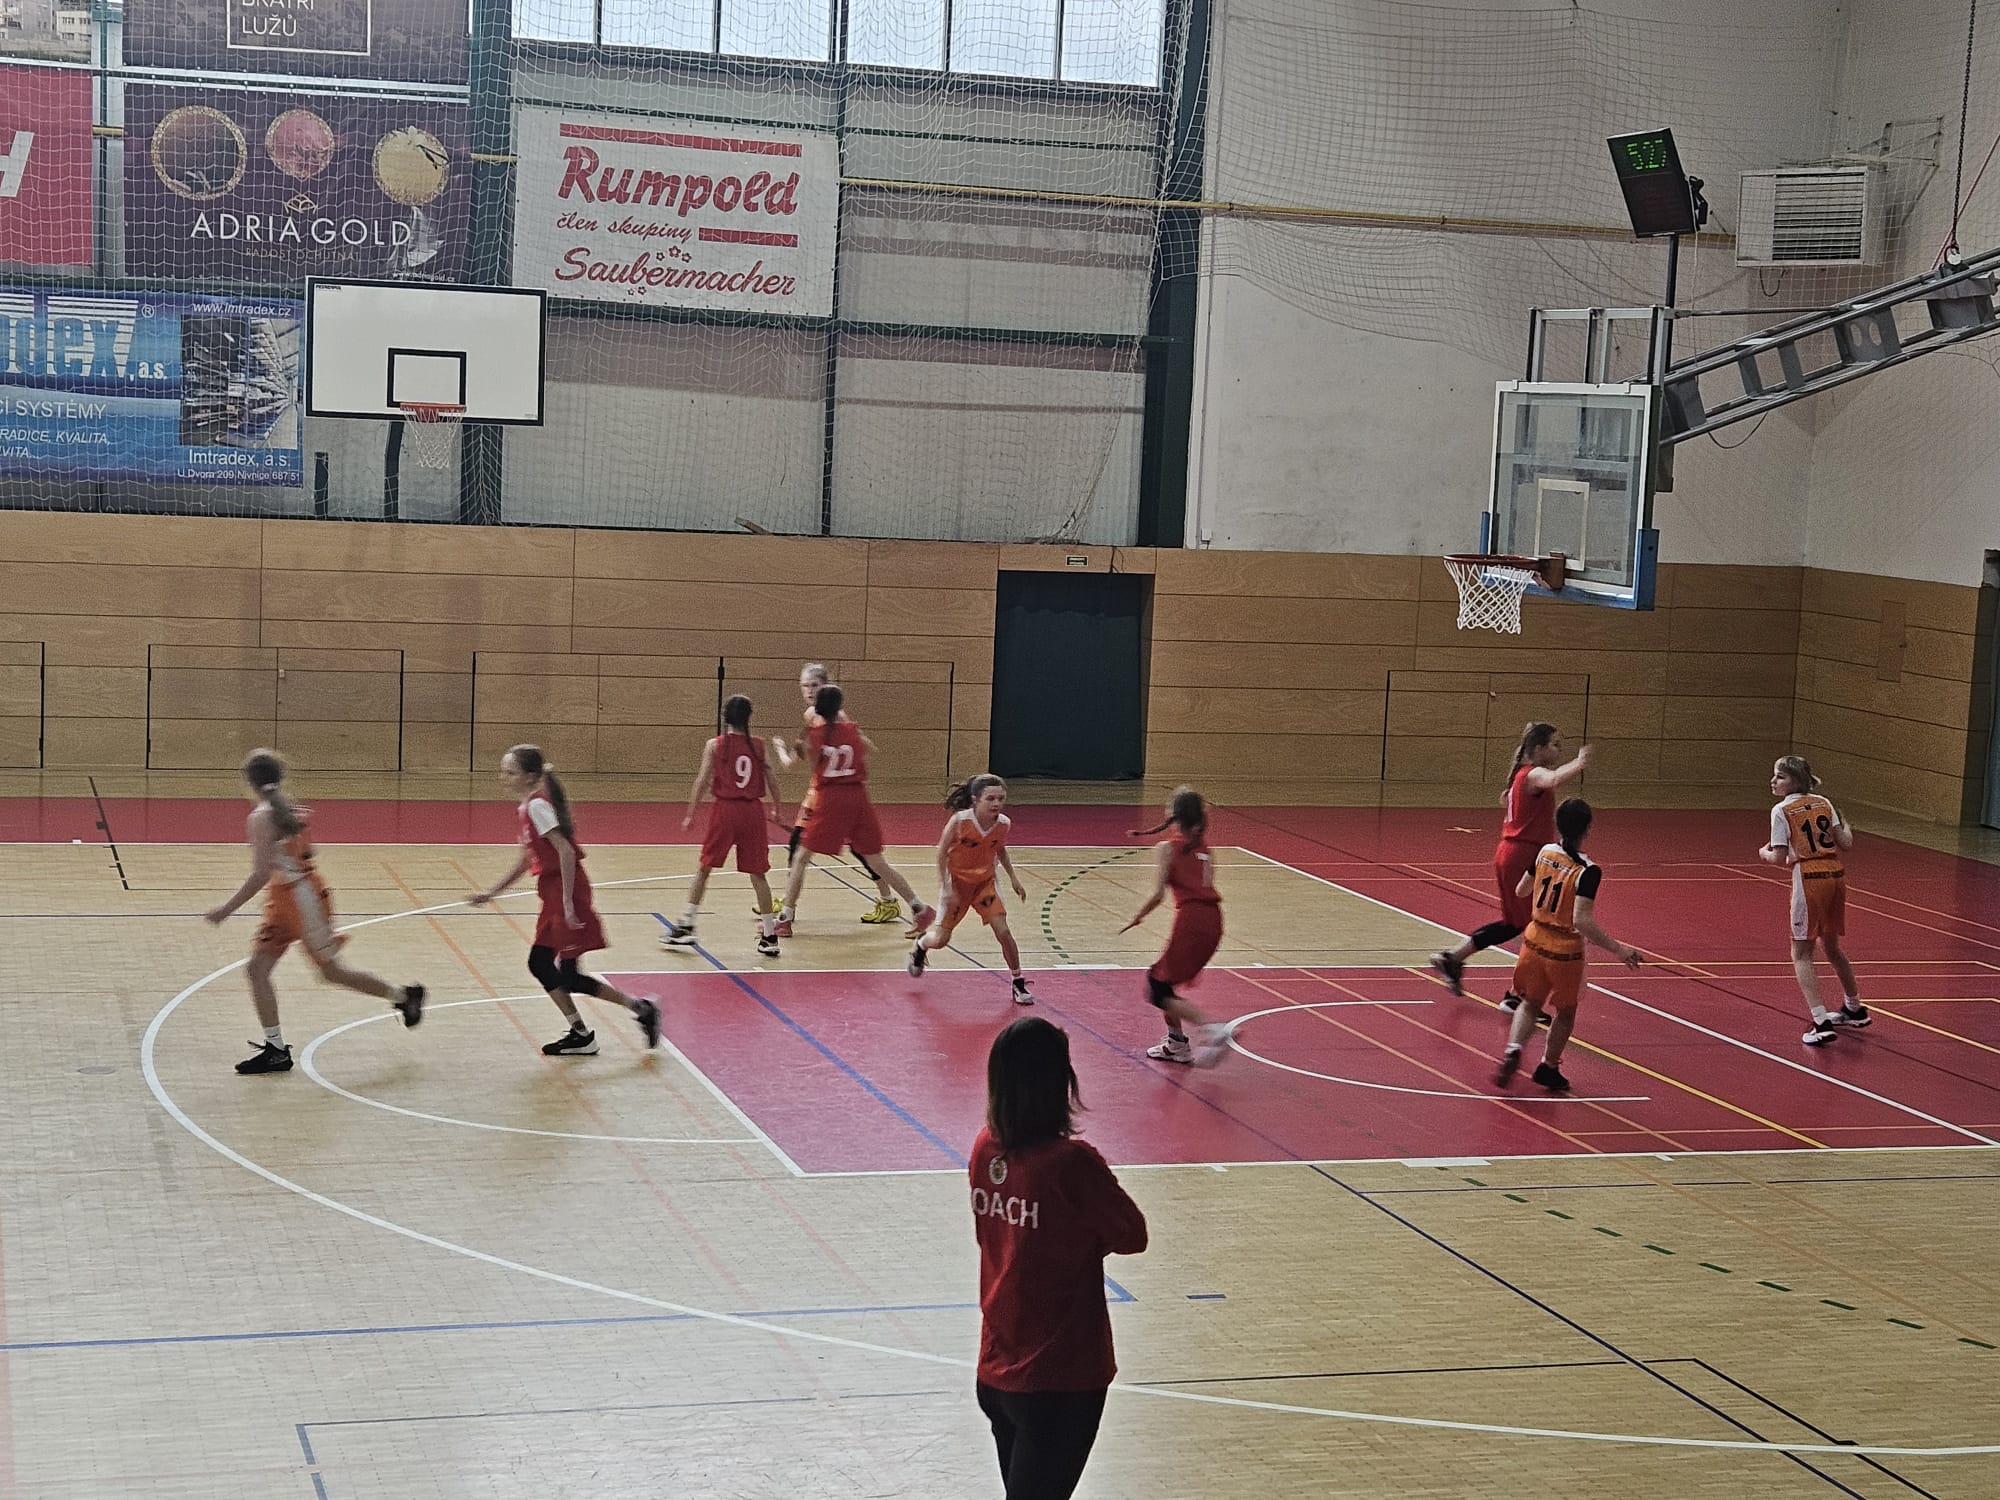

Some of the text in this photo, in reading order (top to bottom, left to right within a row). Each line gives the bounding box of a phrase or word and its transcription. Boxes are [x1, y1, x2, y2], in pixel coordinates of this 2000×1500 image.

[242, 14, 297, 36] LUŽŮ
[558, 145, 800, 217] Rumpold
[190, 212, 411, 246] ADRIA GOLD
[557, 212, 693, 243] člen skupiny
[555, 247, 796, 295] Saubermacher
[56, 430, 111, 446] KVALITA,
[177, 468, 186, 478] U
[271, 471, 289, 480] 687
[189, 448, 291, 467] Imtradex, a.s.
[735, 755, 753, 789] 9
[821, 744, 857, 778] 22
[1801, 814, 1836, 853] 18
[1536, 875, 1563, 913] 11
[971, 1187, 1039, 1229] OACH
